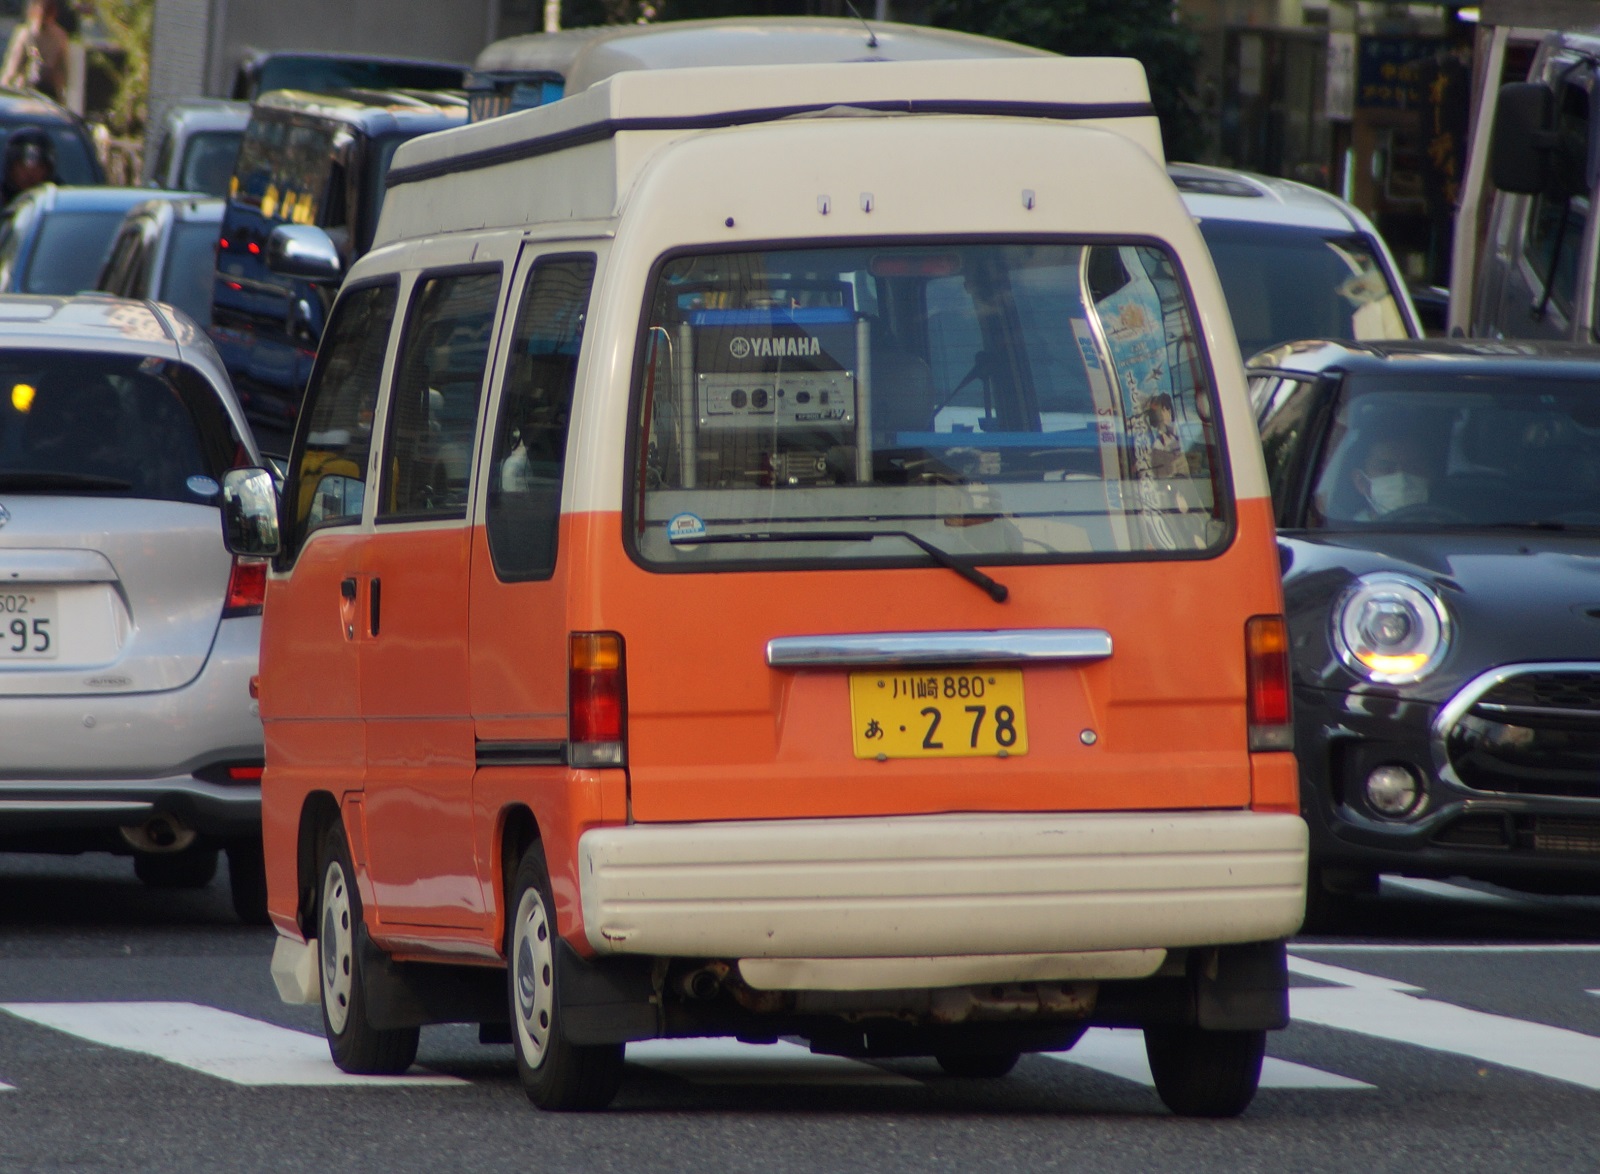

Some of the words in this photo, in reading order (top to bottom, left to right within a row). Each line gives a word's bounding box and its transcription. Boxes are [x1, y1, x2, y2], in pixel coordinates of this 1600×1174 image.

[750, 336, 822, 358] YAMAHA
[892, 677, 939, 700] 川崎
[943, 676, 985, 699] 880
[864, 718, 884, 740] あ
